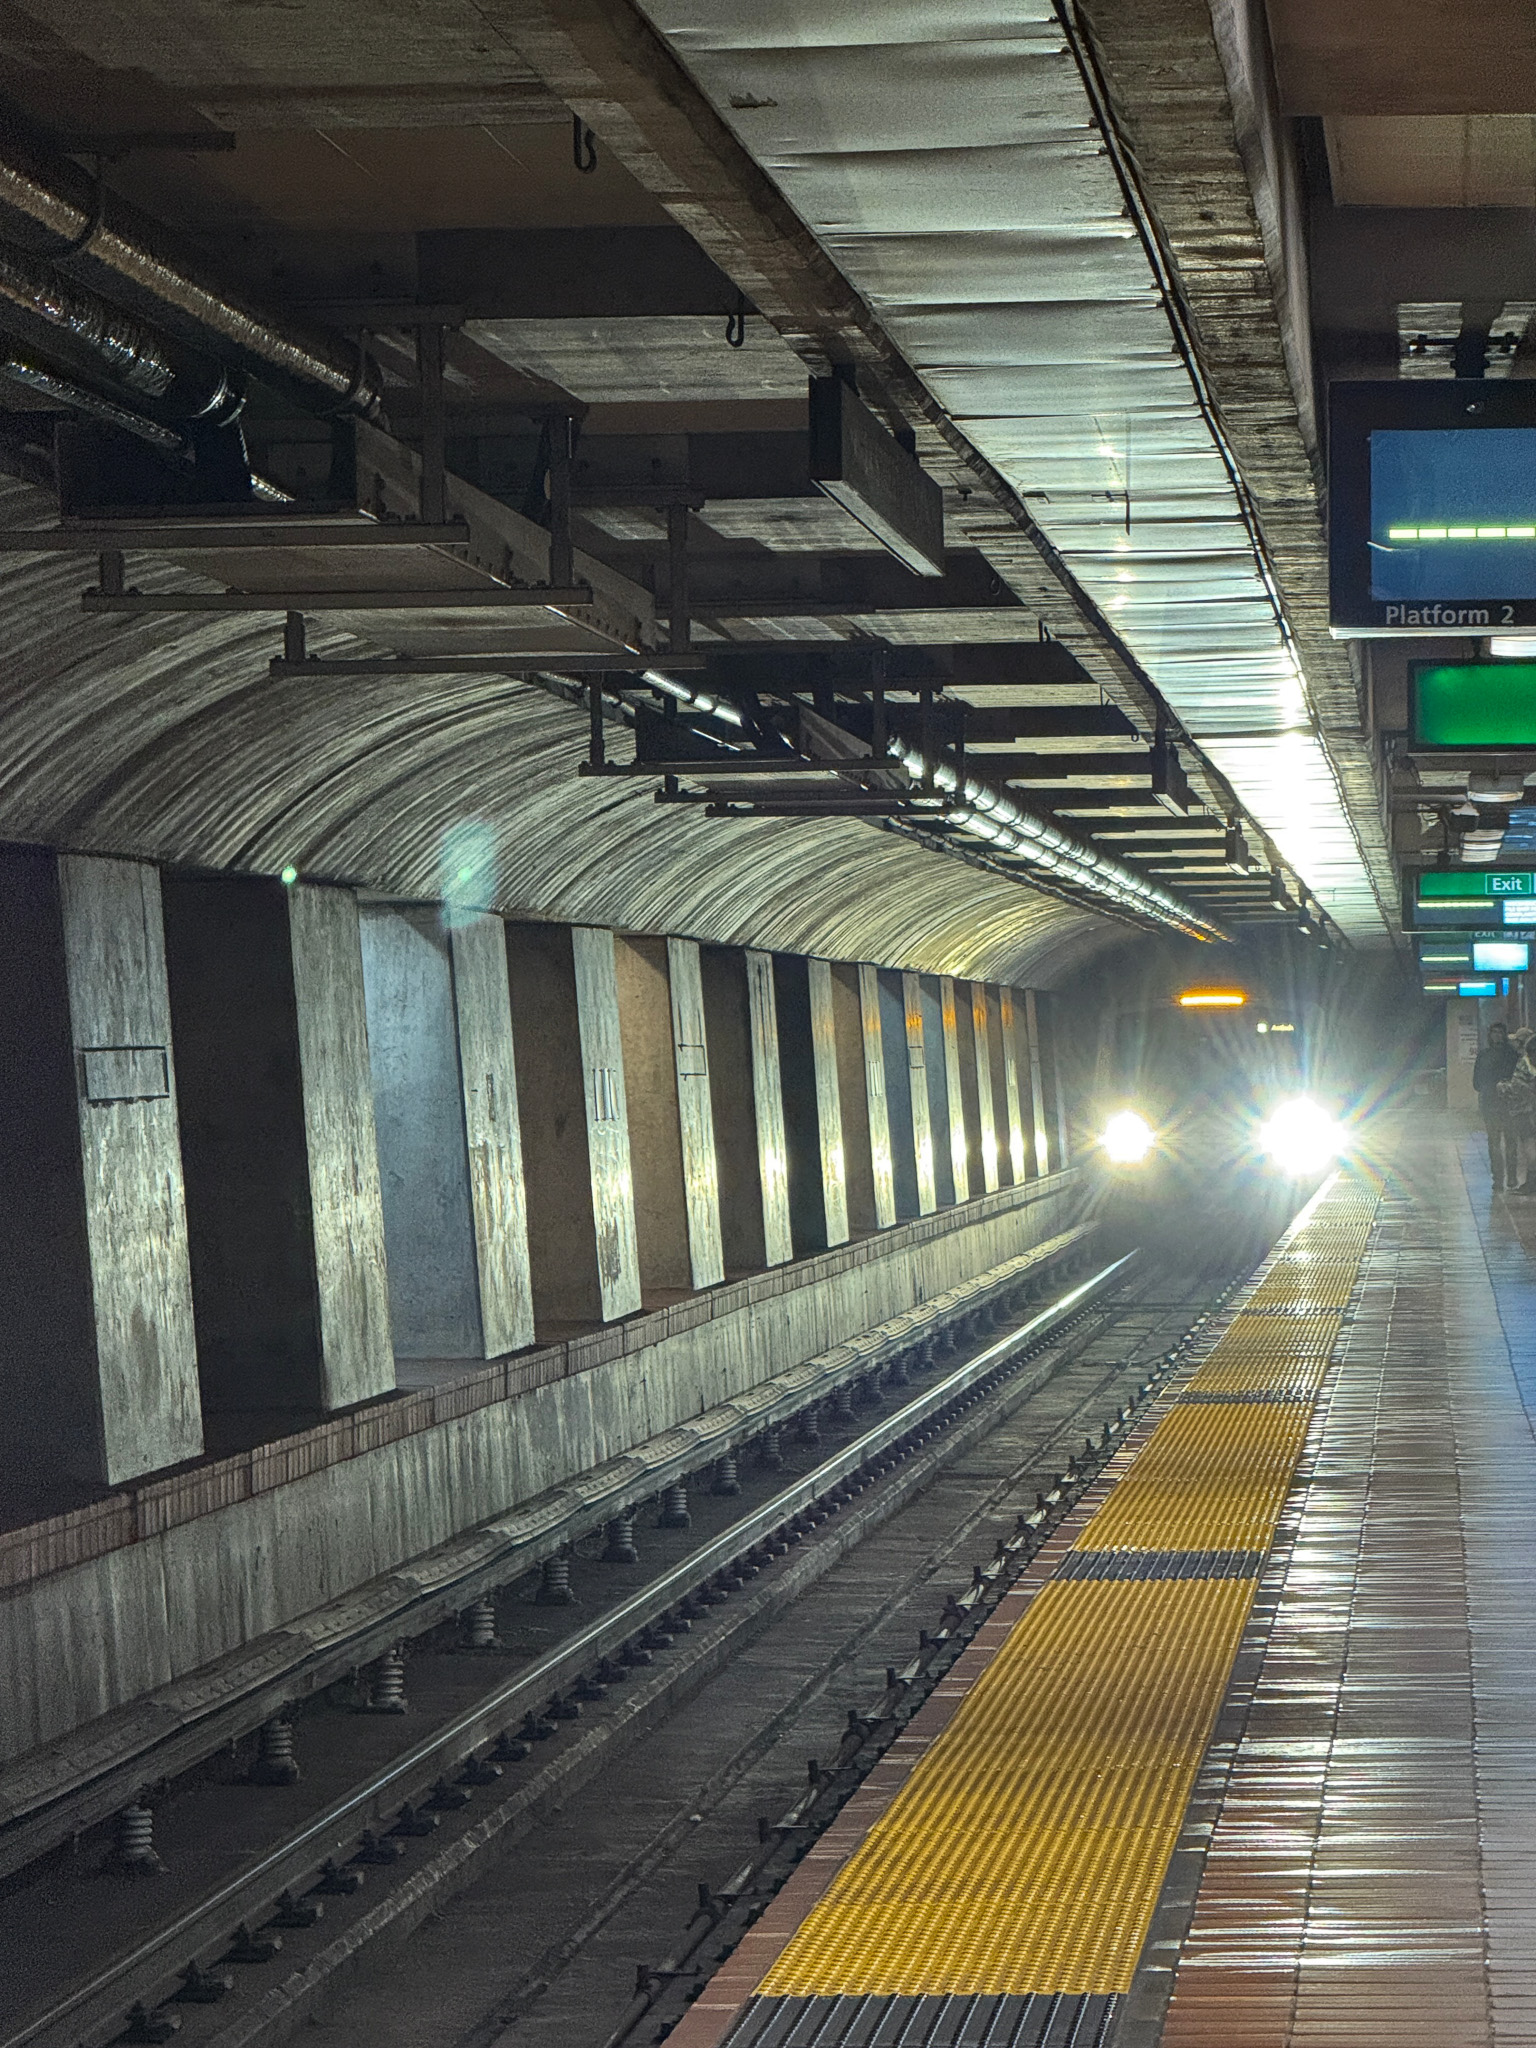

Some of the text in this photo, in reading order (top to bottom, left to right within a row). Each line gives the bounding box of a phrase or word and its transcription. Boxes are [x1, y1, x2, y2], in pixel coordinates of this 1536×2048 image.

[1386, 604, 1514, 625] Platform 2
[1492, 876, 1522, 891] Exit
